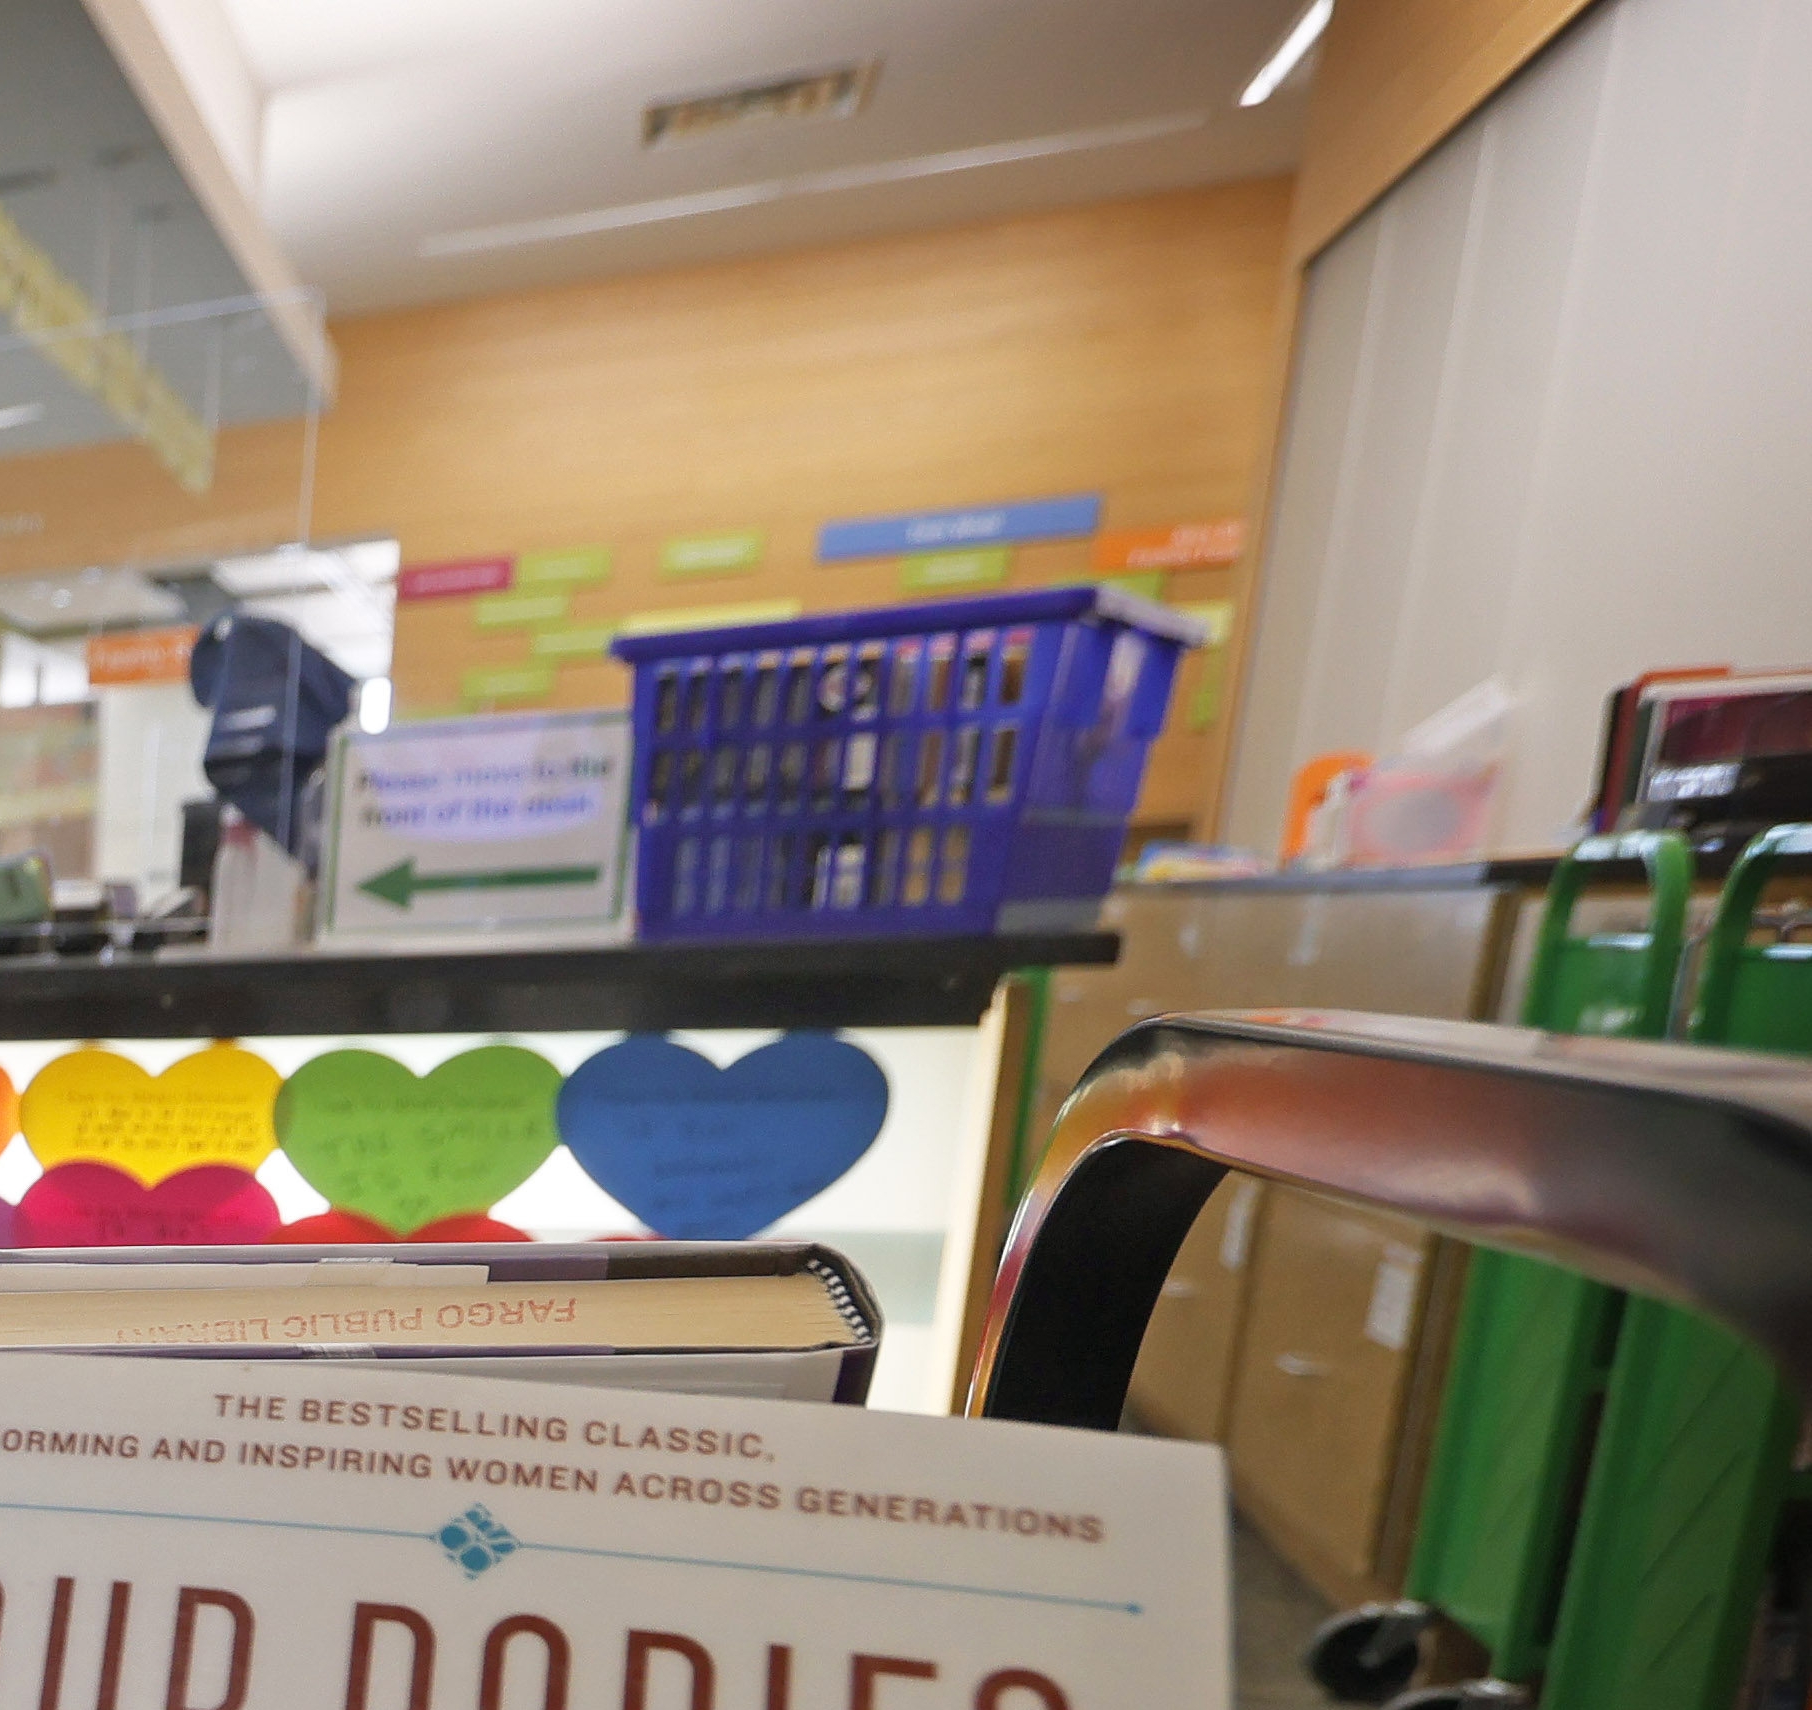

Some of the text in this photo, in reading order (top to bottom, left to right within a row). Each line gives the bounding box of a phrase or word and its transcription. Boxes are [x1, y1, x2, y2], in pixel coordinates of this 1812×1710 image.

[282, 1305, 423, 1338] PUBLIC
[436, 1297, 577, 1329] FARGO
[213, 1393, 775, 1463] THE BESTSELLING CLASSIC,
[150, 1434, 228, 1465] AND
[237, 1440, 436, 1481] INSPIRING
[444, 1455, 601, 1495] WOMEN
[612, 1469, 784, 1511] ACROSS
[795, 1486, 1107, 1546] GENERATIONS
